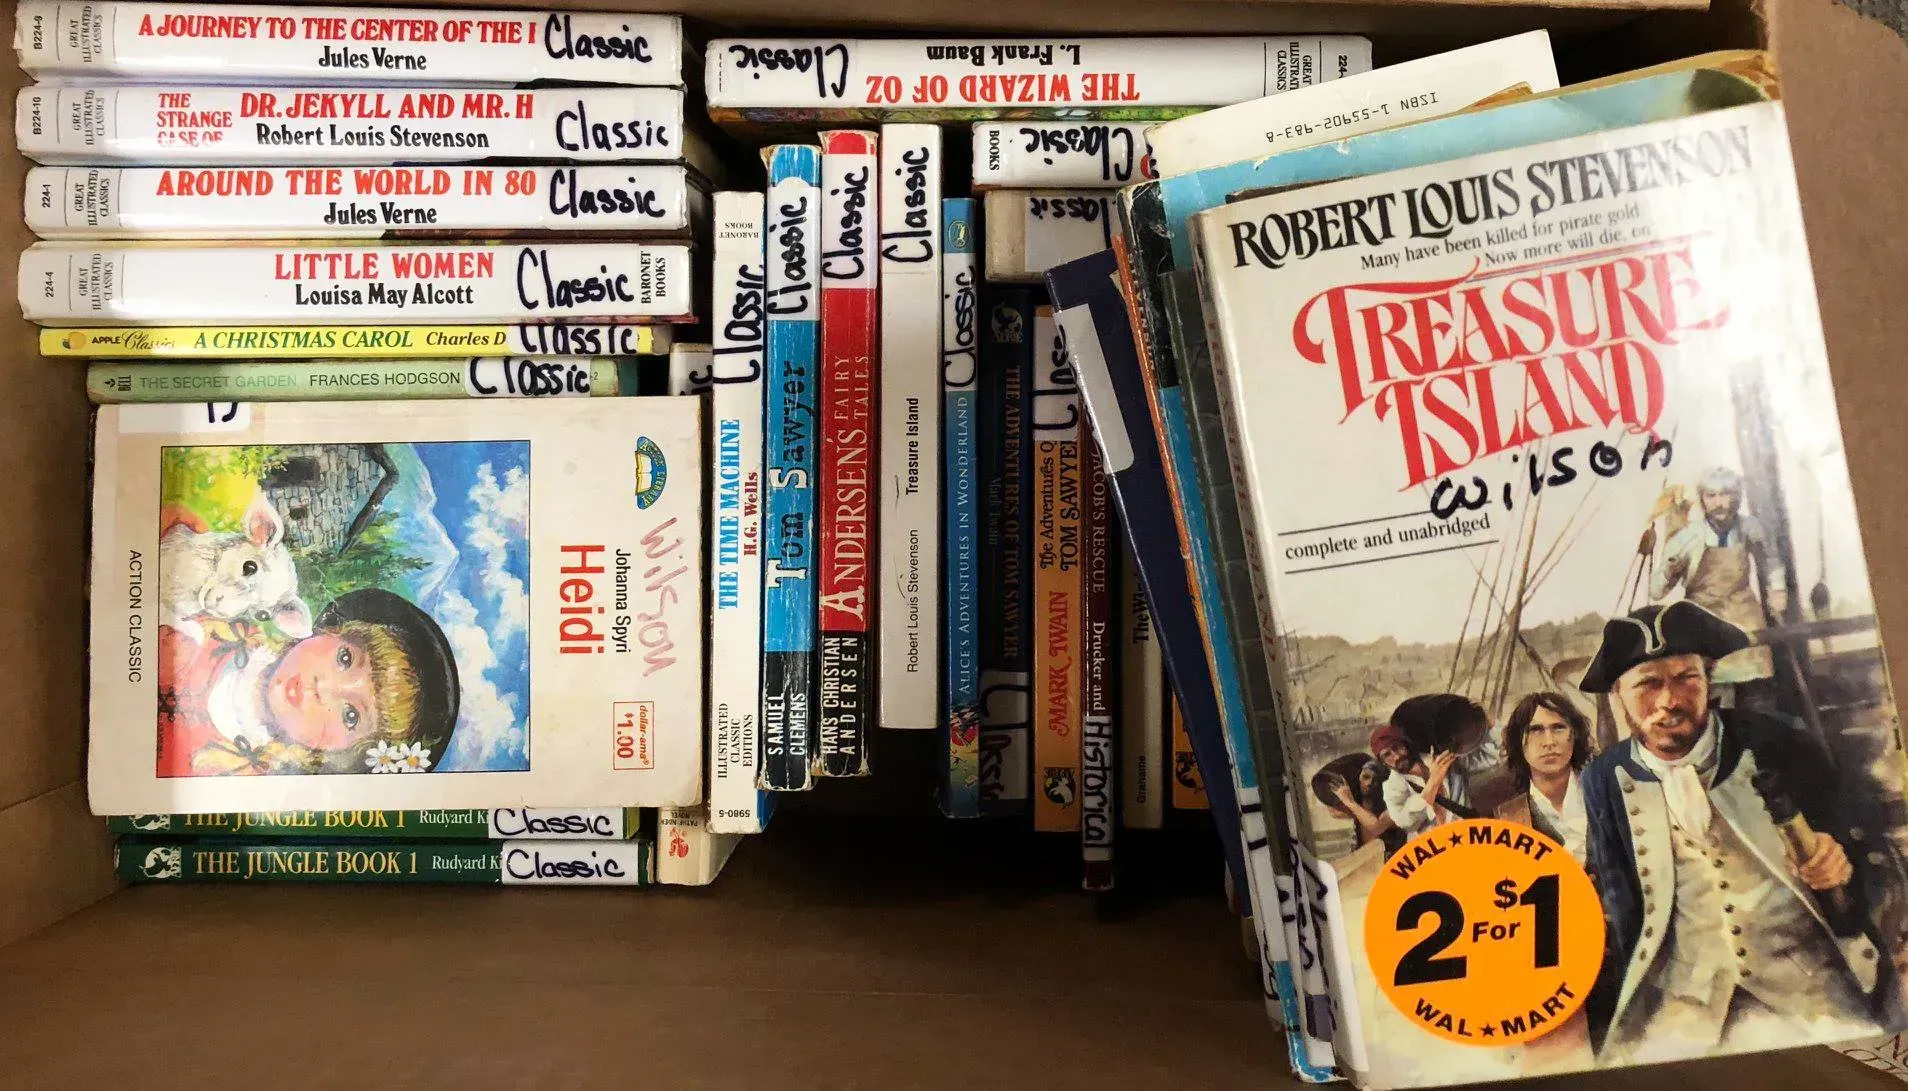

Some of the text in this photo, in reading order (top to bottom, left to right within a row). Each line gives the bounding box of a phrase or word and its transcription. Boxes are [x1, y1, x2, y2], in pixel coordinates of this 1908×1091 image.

[138, 14, 153, 36] A
[157, 15, 263, 39] JOURNEY
[265, 17, 297, 39] TO
[302, 18, 347, 40] THE
[351, 18, 437, 42] CENTER
[442, 20, 472, 43] OF
[477, 21, 522, 43] THE
[544, 13, 653, 63] Classic
[318, 45, 427, 71] Jules Verne
[728, 43, 848, 98] Classic
[926, 44, 1053, 66] Frank Baum
[158, 93, 191, 108] THE
[240, 92, 283, 119] DR.
[286, 92, 391, 119] JEKYLL
[399, 93, 455, 119] AND
[461, 93, 511, 119] MR.
[865, 73, 1140, 104] THE WIZARD OF OZ
[33, 96, 42, 135] B224-10
[156, 110, 233, 128] STRANGE
[256, 123, 490, 148] Robert Louis Stevenson
[556, 100, 669, 152] Classic
[1265, 92, 1439, 143] ISBN 1-55902-983-8
[989, 130, 1000, 171] BOOKS
[1020, 127, 1134, 182] Classic
[42, 184, 52, 208] 224-1
[156, 169, 537, 196] AROUND THE WORLD IN 80
[549, 169, 666, 219] Classic
[882, 146, 933, 263] Classic
[1227, 126, 1754, 270] ROBERT LOUIS STEVENSON
[324, 202, 438, 225] Jules Verne
[719, 231, 759, 239] BARONET
[822, 166, 869, 280] Classic
[1361, 203, 1640, 272] Many have been killed for pirate gold
[274, 252, 494, 280] LITTLE WOMEN
[767, 196, 812, 314] Classic
[1485, 249, 1520, 267] Now
[1524, 243, 1563, 260] more
[1567, 233, 1595, 251] will
[45, 271, 54, 298] 224-4
[79, 267, 88, 296] GREAT
[92, 253, 102, 311] ILLUSTRATED
[296, 283, 474, 309] Louisa May Alcott
[517, 247, 634, 310] Classic
[641, 250, 652, 305] BARONET
[655, 256, 667, 298] BOOKS
[91, 336, 121, 345] APPLE
[194, 330, 488, 349] A CHRISTMAS CAROL Charles
[713, 264, 765, 384] Classic
[944, 266, 976, 387] Classic
[1292, 243, 1732, 425] TREASURE
[140, 372, 461, 389] THE SECRET GARDEN FRANCES HODGSON
[469, 355, 590, 396] Classic
[834, 356, 850, 420] FAIRY
[853, 355, 869, 420] TALES
[1374, 340, 1664, 493] ISLAND
[766, 360, 816, 589] Tom Sawyer
[718, 419, 740, 610] THE TIME MACHINE
[743, 472, 758, 556] H.G. Wells
[819, 428, 867, 622] ANDERSEN'S
[905, 397, 919, 673] Robert Louis Stevenson Treasure Island
[1040, 456, 1057, 569] The Adventures
[1091, 452, 1106, 594] JACOB'S RESCUE
[1284, 512, 1491, 561] complete and unabridged
[956, 397, 970, 694] ALICE'S ADVENTURES IN WONDERLAND
[1060, 524, 1078, 571] TOM
[128, 550, 142, 683] ACTION CLASSIC
[559, 545, 605, 654] Heidi
[612, 548, 631, 653] Johanna Spyri
[1049, 590, 1072, 737] MARK TWAIN
[1092, 622, 1106, 711] Drucker and
[822, 637, 841, 755] HANS CHRISTIAN
[839, 637, 858, 755] ANDERSEN
[616, 713, 634, 758] $1.00
[718, 703, 728, 779] ILLUSTRATED
[730, 718, 741, 763] CLASSIC
[743, 714, 753, 767] EDITIONS
[767, 692, 785, 756] SAMUEL
[789, 692, 807, 756] CLEMENS
[1084, 720, 1113, 848] Historical
[324, 808, 473, 828] BOOK Rudyard
[494, 808, 614, 836] Classic
[718, 809, 751, 818] 5980-5
[193, 851, 240, 874] THE
[244, 851, 329, 880] JUNGLE
[336, 851, 401, 874] BOOK
[408, 852, 417, 874] 1
[432, 854, 487, 873] Rudyard
[507, 849, 625, 879] Classic
[1394, 890, 1468, 987] 2
[1472, 921, 1521, 943] For
[1493, 873, 1560, 969] $1
